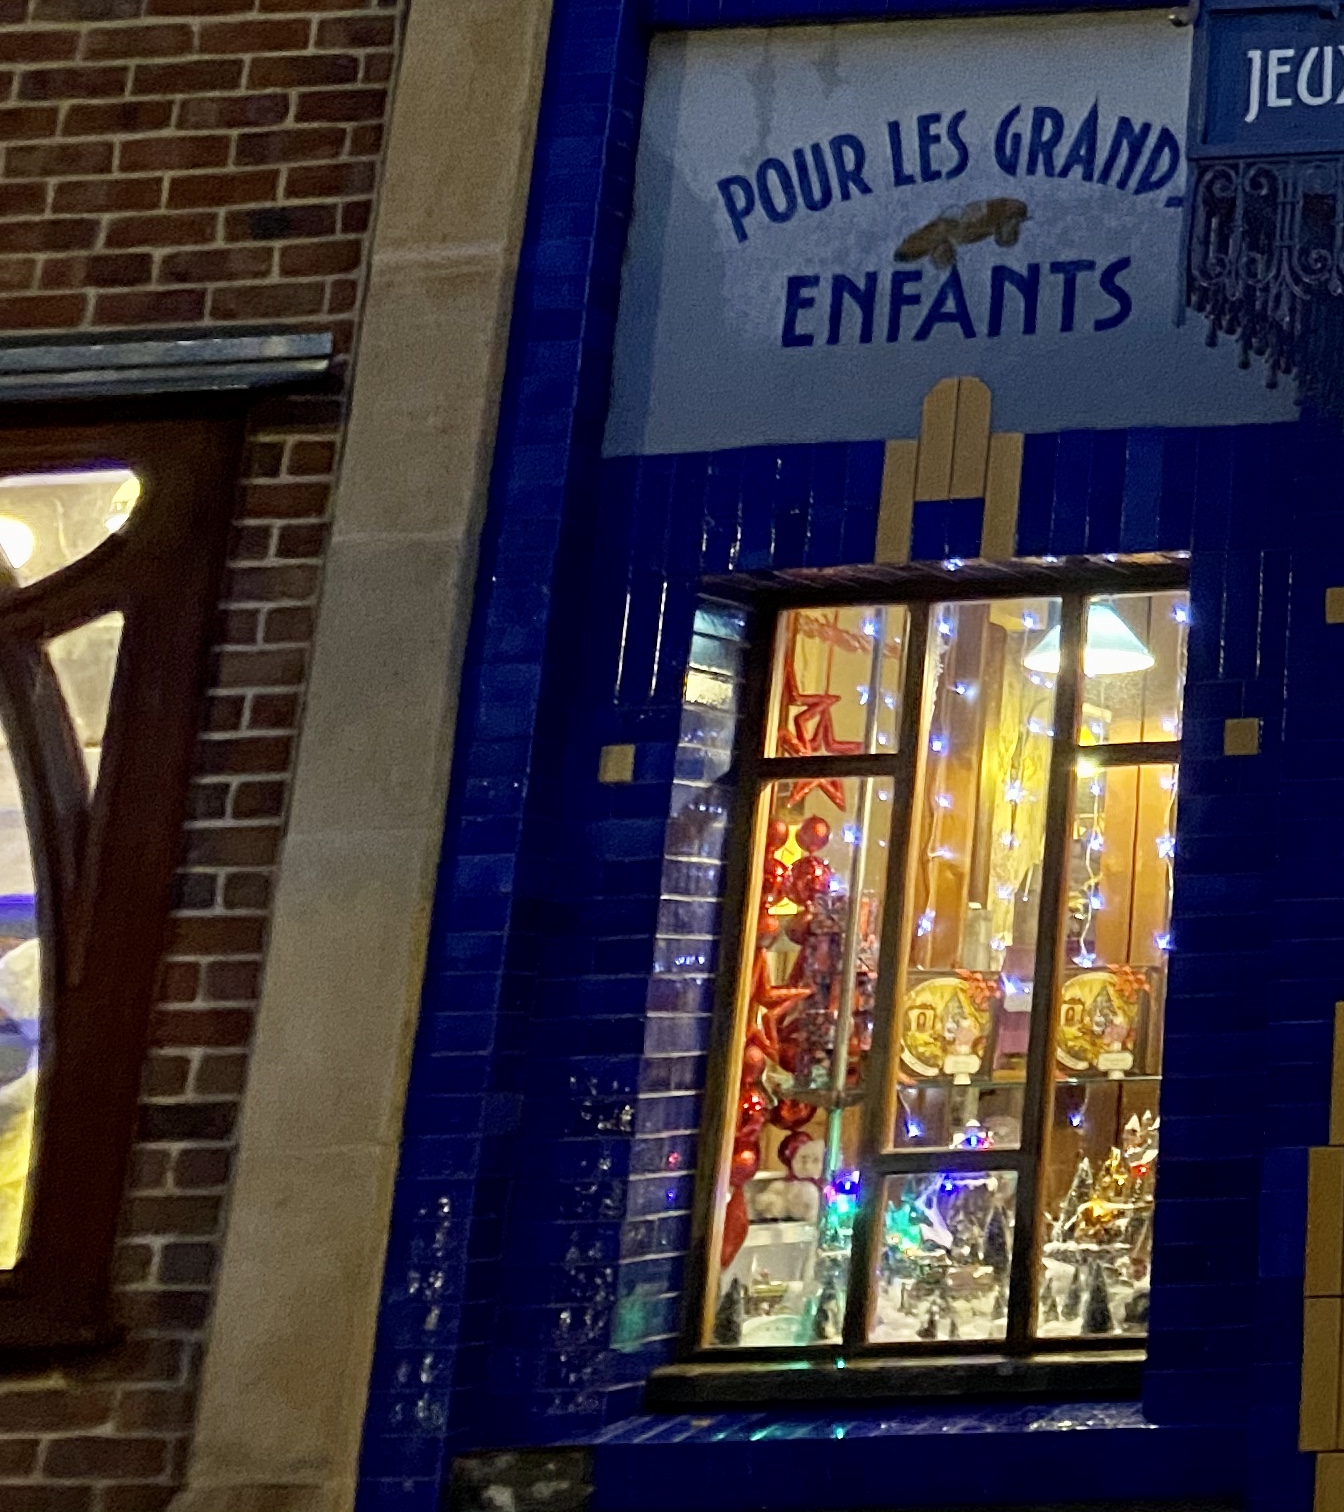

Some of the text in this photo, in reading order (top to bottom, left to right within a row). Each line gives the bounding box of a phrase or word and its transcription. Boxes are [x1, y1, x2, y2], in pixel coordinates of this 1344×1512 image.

[717, 94, 1186, 243] POUR LES GRAND
[780, 256, 1132, 348] ENFANTS
